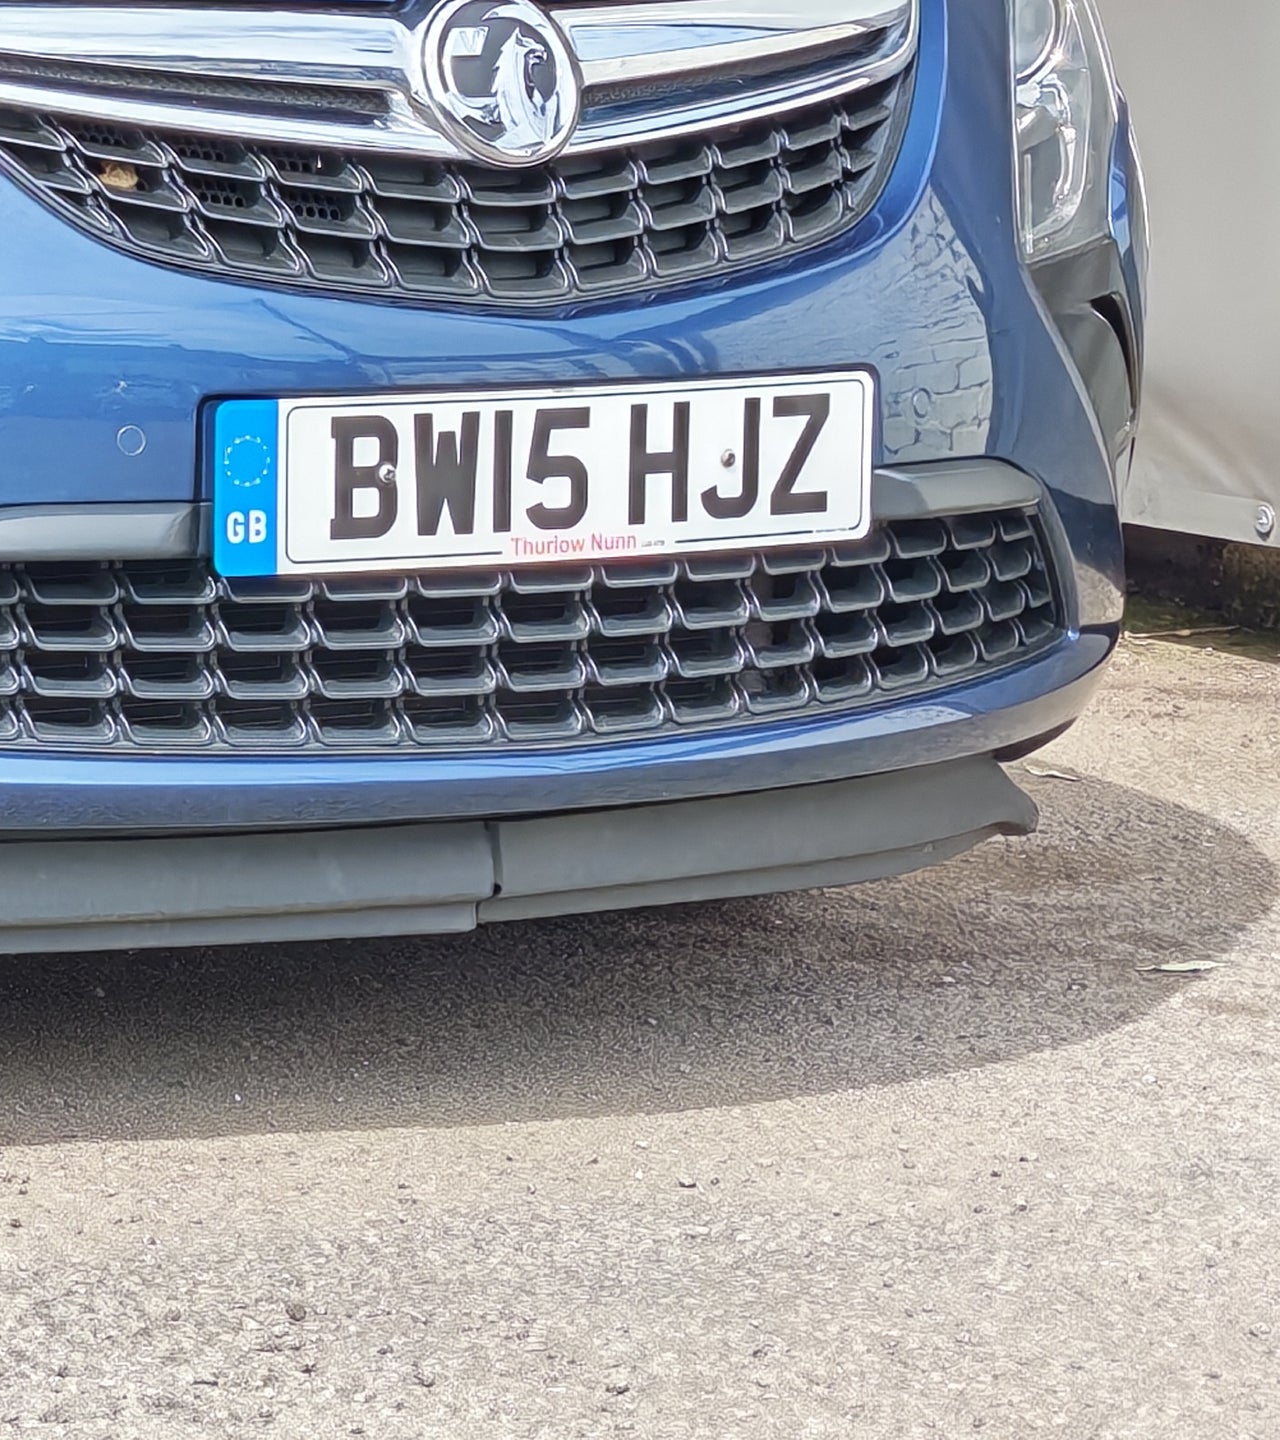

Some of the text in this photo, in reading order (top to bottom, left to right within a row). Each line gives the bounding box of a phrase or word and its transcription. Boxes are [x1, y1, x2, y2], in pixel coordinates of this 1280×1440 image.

[330, 393, 831, 540] BW15 HJZ
[226, 509, 267, 544] GB
[510, 533, 636, 556] Thurlow Nunn
